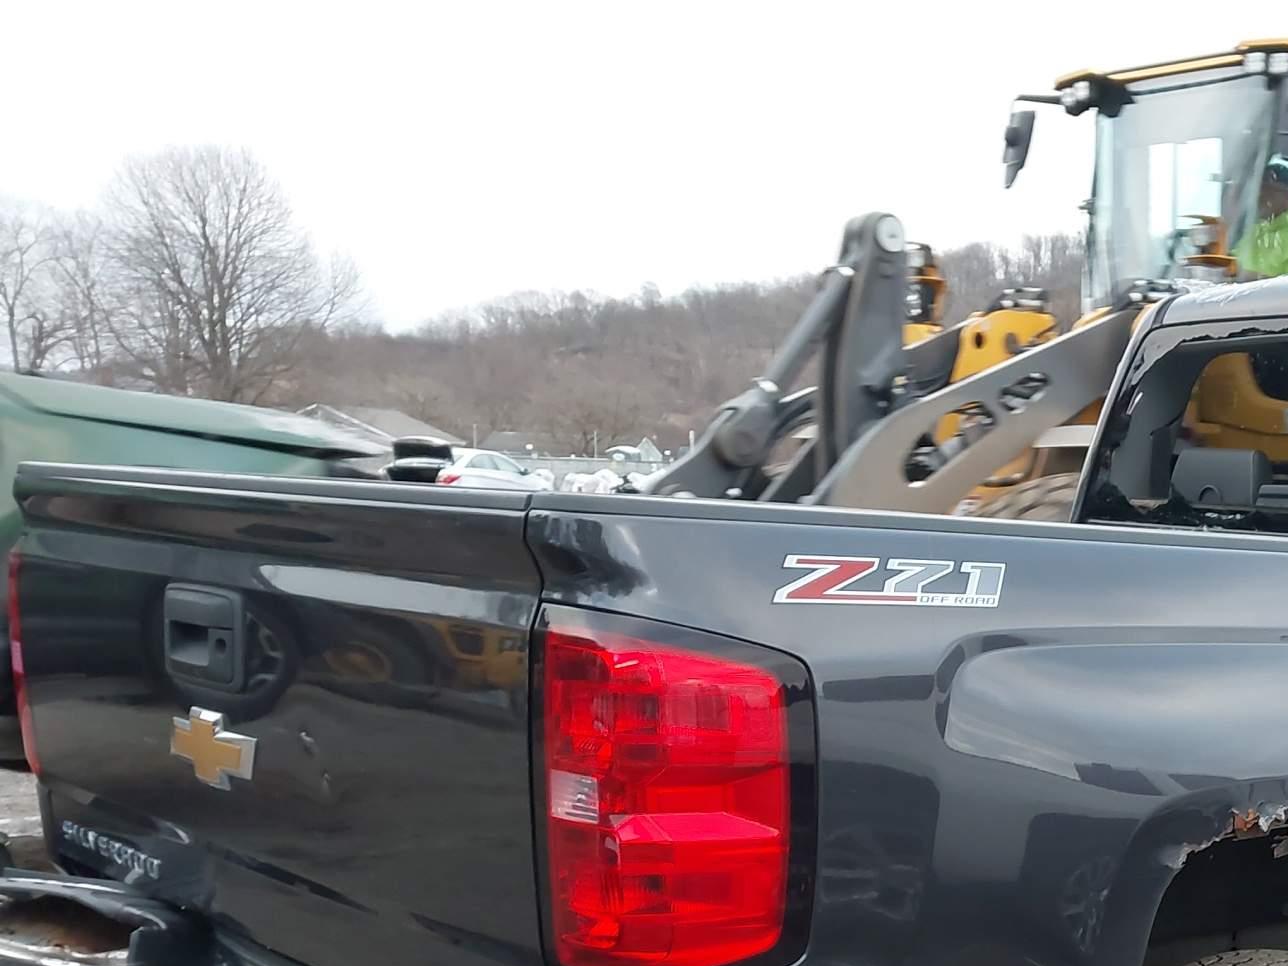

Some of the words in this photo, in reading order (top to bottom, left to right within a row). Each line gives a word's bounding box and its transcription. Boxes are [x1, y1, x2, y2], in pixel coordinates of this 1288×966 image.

[773, 554, 1007, 605] Z71
[919, 595, 951, 605] OFF
[954, 596, 997, 606] ROAD
[62, 820, 161, 879] SILVERADO
